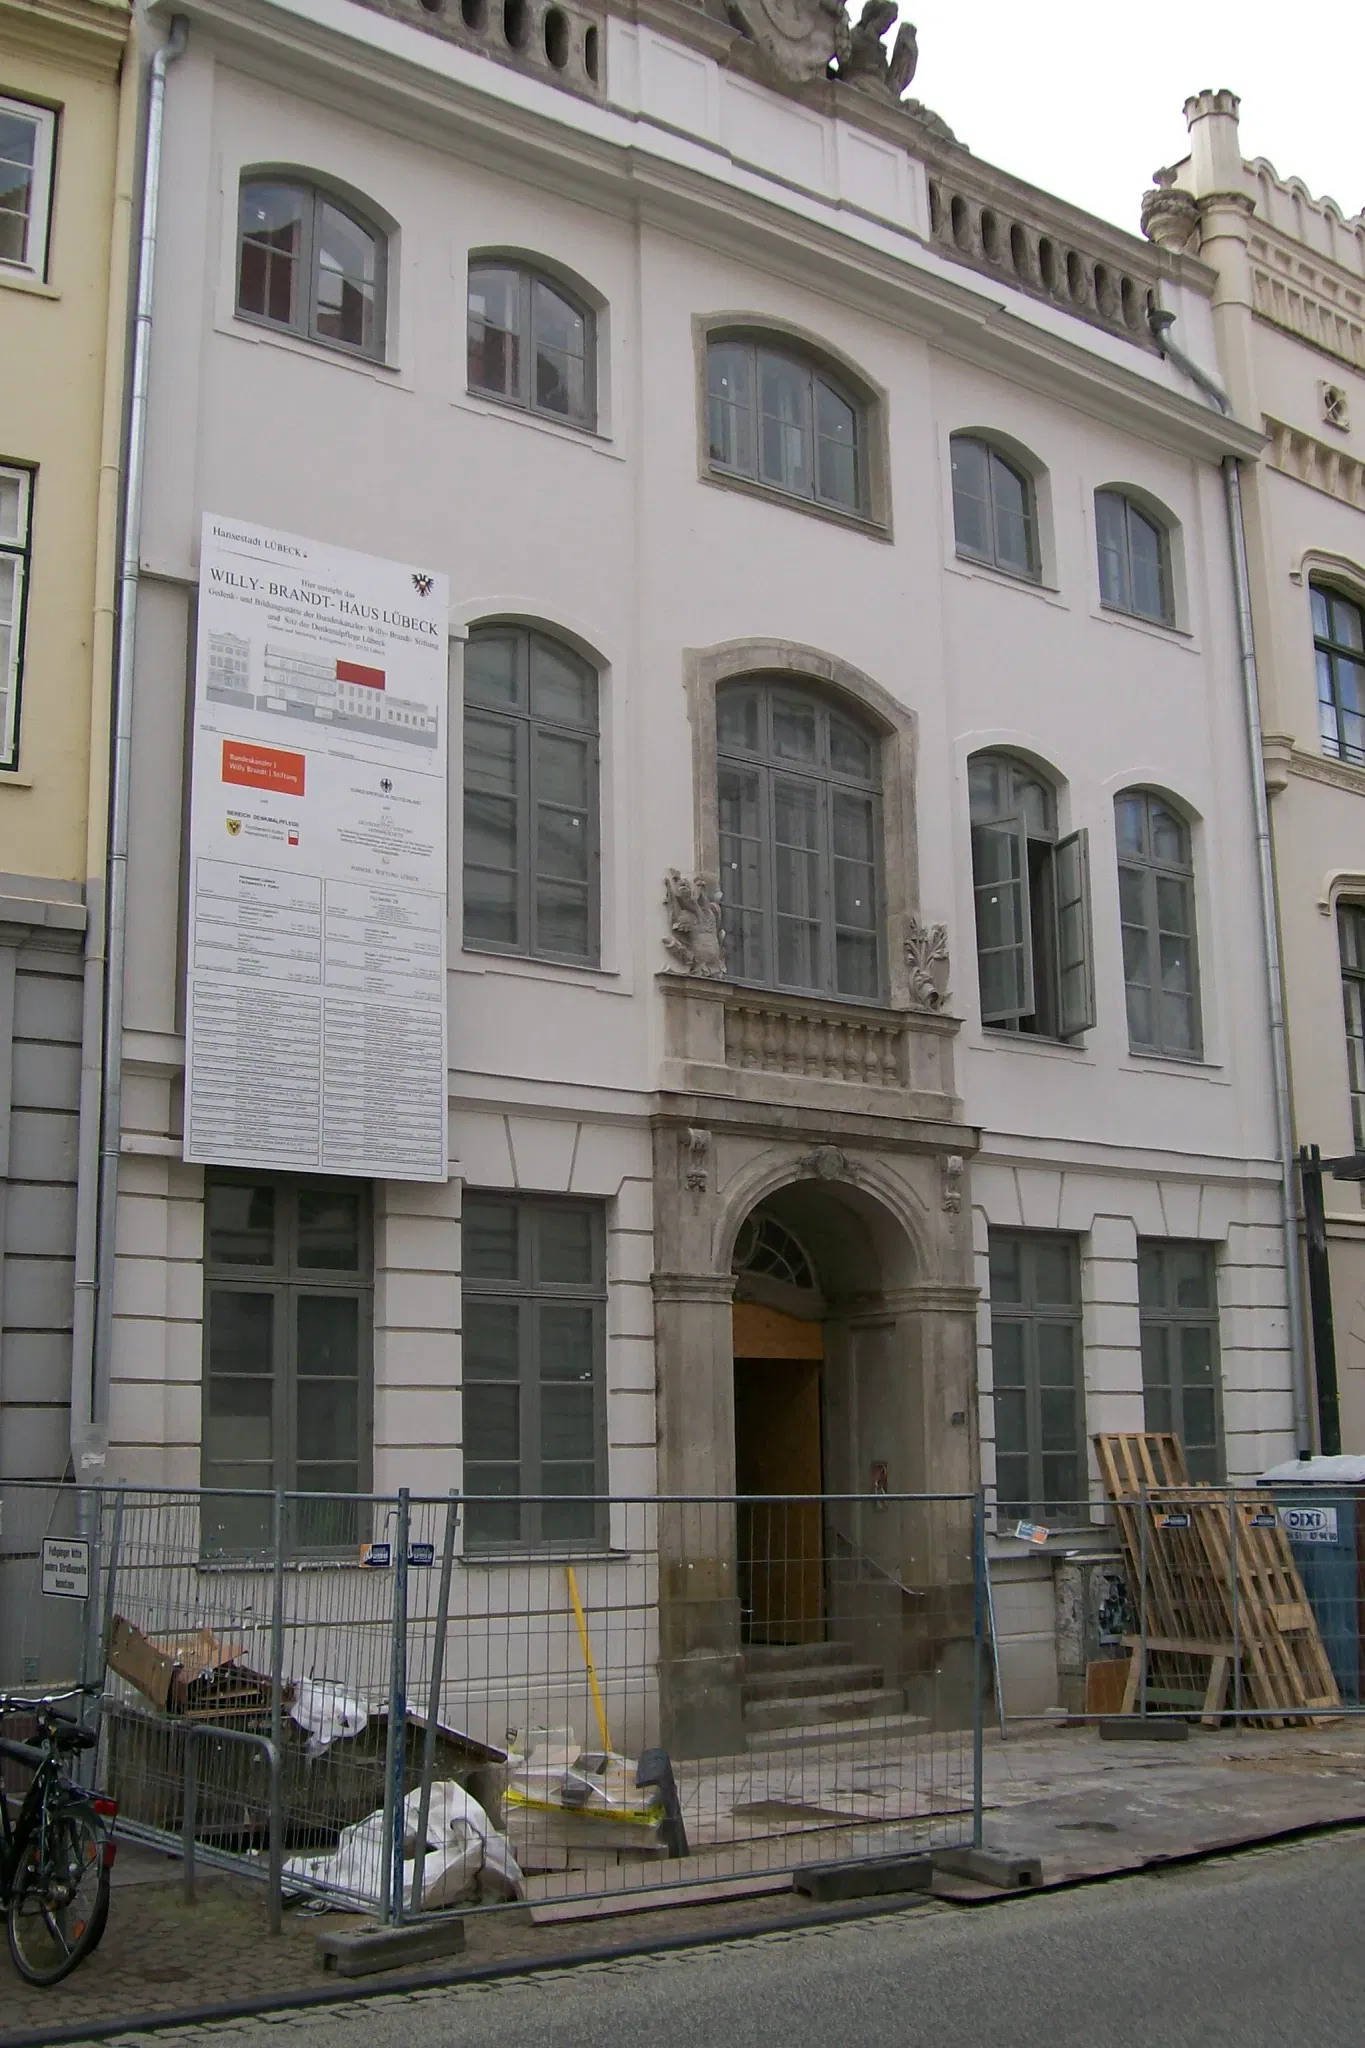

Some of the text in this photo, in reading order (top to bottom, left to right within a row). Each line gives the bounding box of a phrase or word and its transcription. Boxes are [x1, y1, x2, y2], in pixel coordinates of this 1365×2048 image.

[213, 526, 302, 557] Hansestadt LÜBECK
[210, 567, 439, 636] WILLY- BRANDT- HAUS LÜBECK
[267, 613, 281, 622] und
[284, 616, 298, 625] Sitz
[299, 619, 310, 629] der
[362, 635, 386, 647] Lübeck
[303, 609, 315, 619] der
[414, 637, 439, 651] Stiftung
[229, 753, 273, 768] Bundeskanzler
[229, 762, 298, 783] Willy Brandt Stiftung
[226, 809, 251, 819] BEREICH
[48, 1545, 82, 1559] Fußgänger bitte
